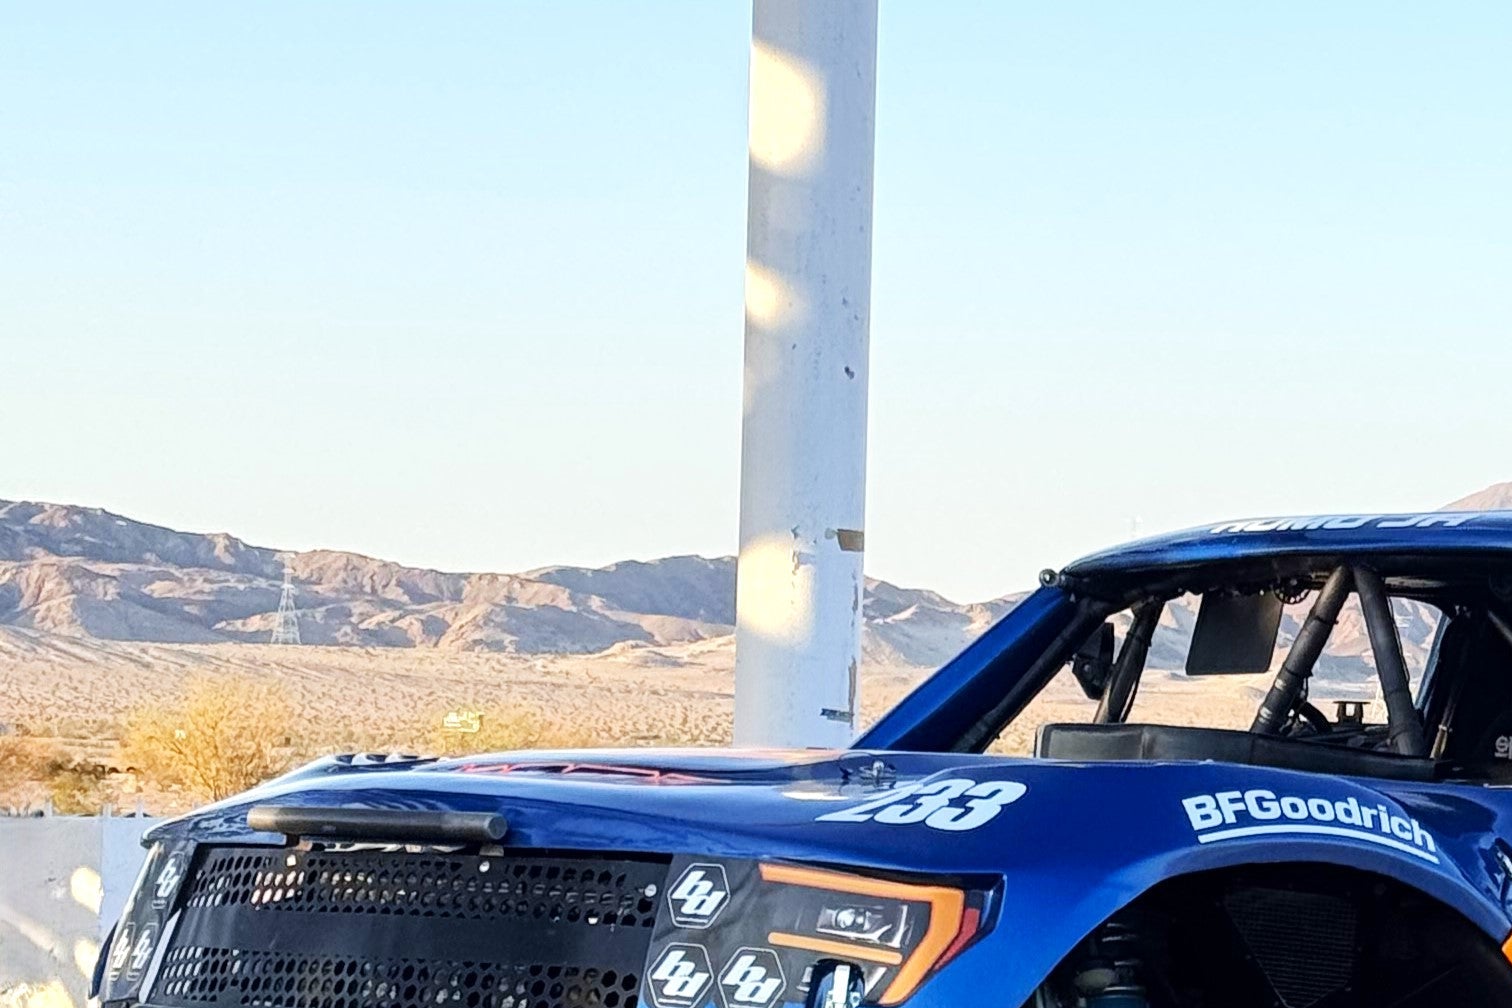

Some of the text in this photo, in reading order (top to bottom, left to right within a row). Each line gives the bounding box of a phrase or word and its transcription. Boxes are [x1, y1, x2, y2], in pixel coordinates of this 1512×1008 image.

[815, 779, 1027, 831] 233
[1182, 789, 1436, 852] BFGoodrich
[671, 869, 714, 916] bd
[652, 949, 700, 998] bd
[722, 952, 774, 1004] bd
